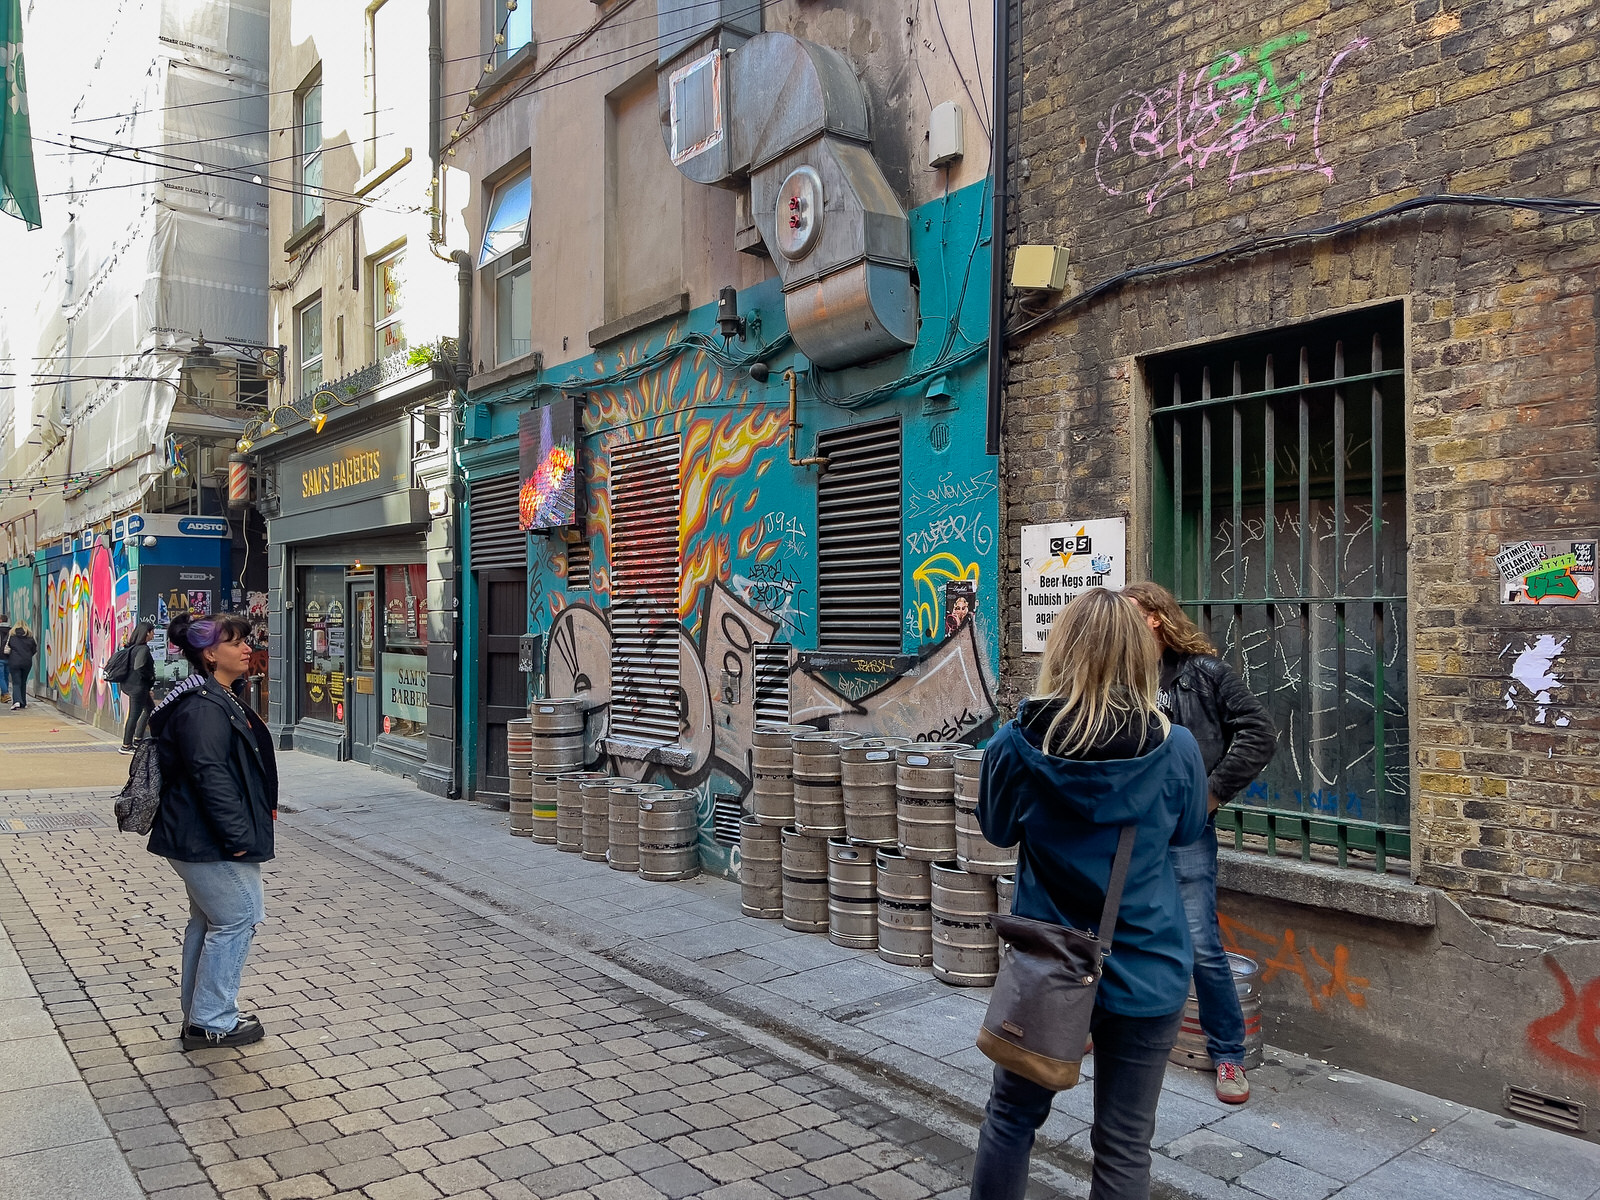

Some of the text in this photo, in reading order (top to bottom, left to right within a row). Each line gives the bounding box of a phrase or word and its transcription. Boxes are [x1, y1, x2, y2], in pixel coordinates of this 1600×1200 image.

[301, 449, 381, 498] SAM'S BARBERS
[1496, 542, 1532, 565] OPTIMIST
[1501, 551, 1536, 573] ATLANTIC
[1039, 573, 1103, 588] Beer Kegs and
[1504, 558, 1540, 581] ISLANDER
[1028, 593, 1062, 606] Rubbish
[398, 668, 427, 688] SAM'S
